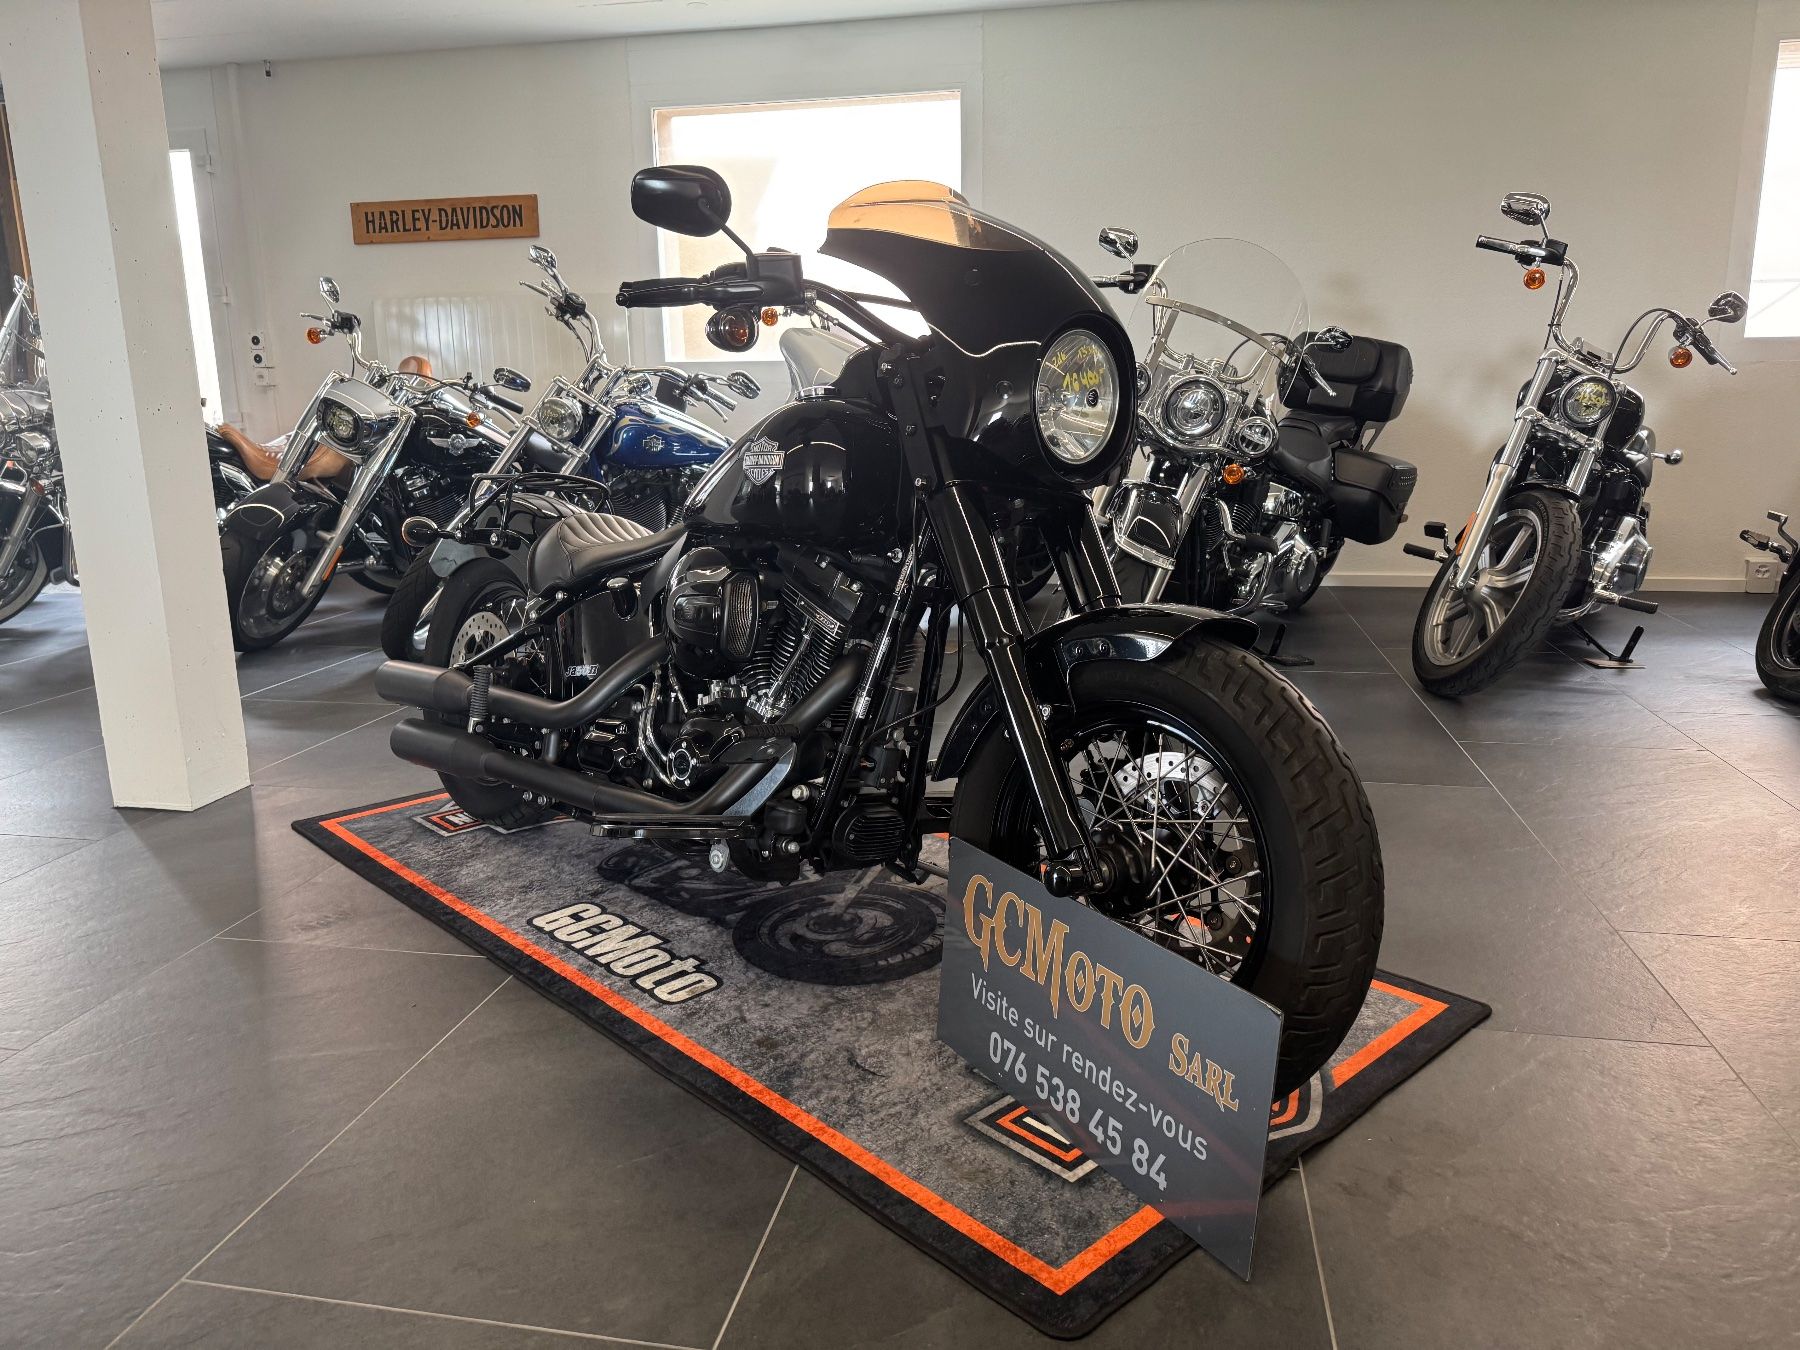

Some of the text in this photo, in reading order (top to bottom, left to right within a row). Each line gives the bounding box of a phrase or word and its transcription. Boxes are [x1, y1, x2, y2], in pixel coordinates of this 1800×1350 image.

[364, 204, 523, 234] HARLEY-DAVIDSON
[532, 903, 718, 1003] GCMoto
[971, 972, 1208, 1161] Visite sur rendez-vous
[989, 1031, 1168, 1192] 076 538 45 84
[1168, 1032, 1239, 1112] SARL
